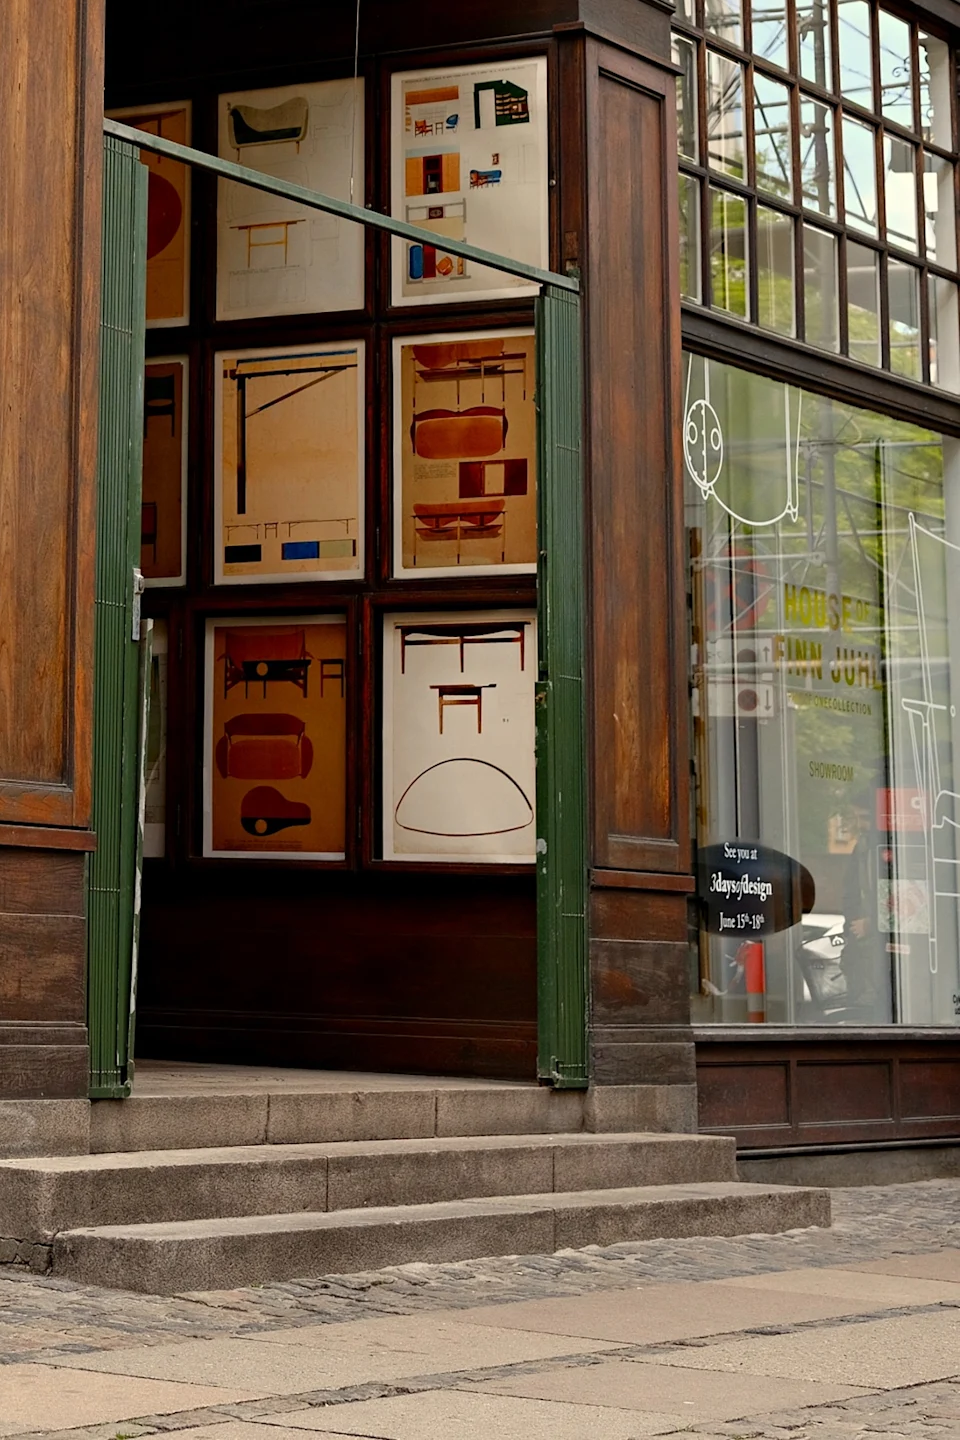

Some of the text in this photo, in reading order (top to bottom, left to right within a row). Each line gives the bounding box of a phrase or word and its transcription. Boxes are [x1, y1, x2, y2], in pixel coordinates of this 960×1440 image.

[784, 582, 854, 635] HOUSE
[774, 634, 883, 691] FINN JUHL
[809, 760, 854, 782] SHOWROOM
[724, 842, 757, 863] See you at
[709, 871, 772, 902] 3daysofdesign
[719, 912, 735, 931] June
